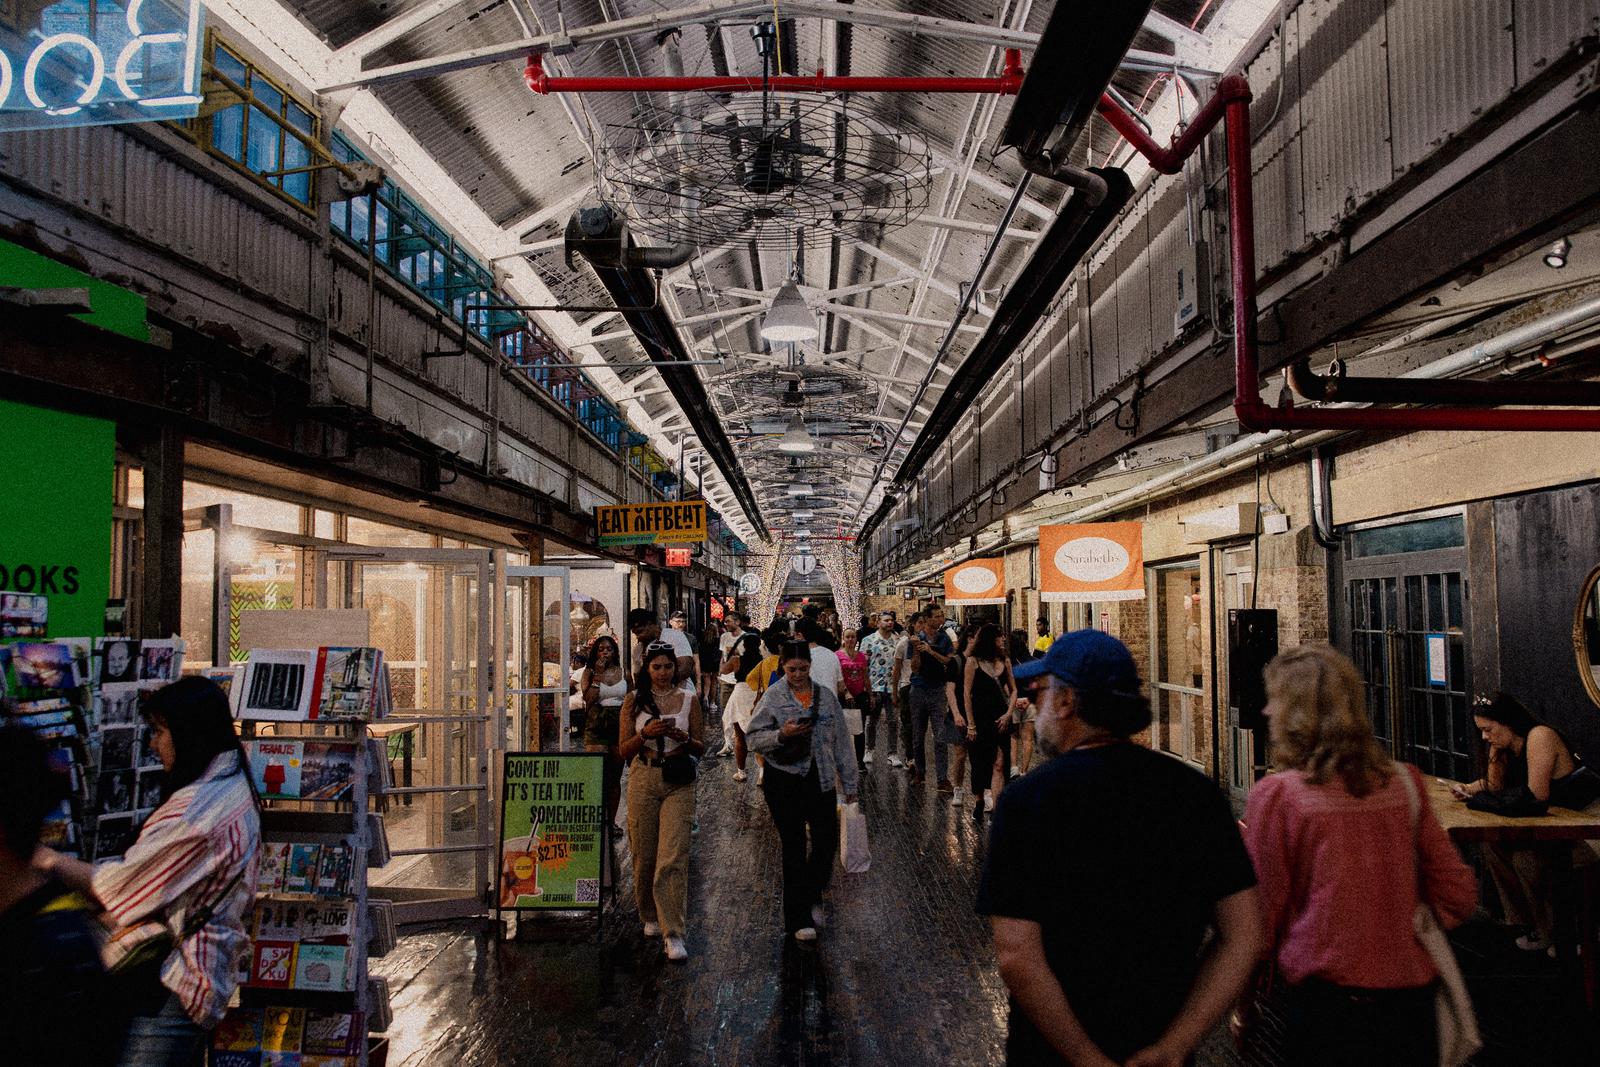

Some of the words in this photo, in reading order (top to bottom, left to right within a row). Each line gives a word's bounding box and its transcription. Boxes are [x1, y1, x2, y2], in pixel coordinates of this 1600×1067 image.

[600, 508, 630, 534] EAT
[634, 505, 702, 532] OFFBEAT
[259, 744, 295, 755] PEANUTS
[506, 760, 539, 778] COME
[543, 760, 560, 778] IN!
[506, 782, 528, 801] IT'S
[532, 782, 552, 801] TEA
[557, 782, 584, 801] TIME
[530, 805, 602, 824] SOMEWHERE
[570, 833, 595, 842] BEVERAGE
[537, 843, 568, 863] $2.75!
[542, 893, 551, 902] EAT
